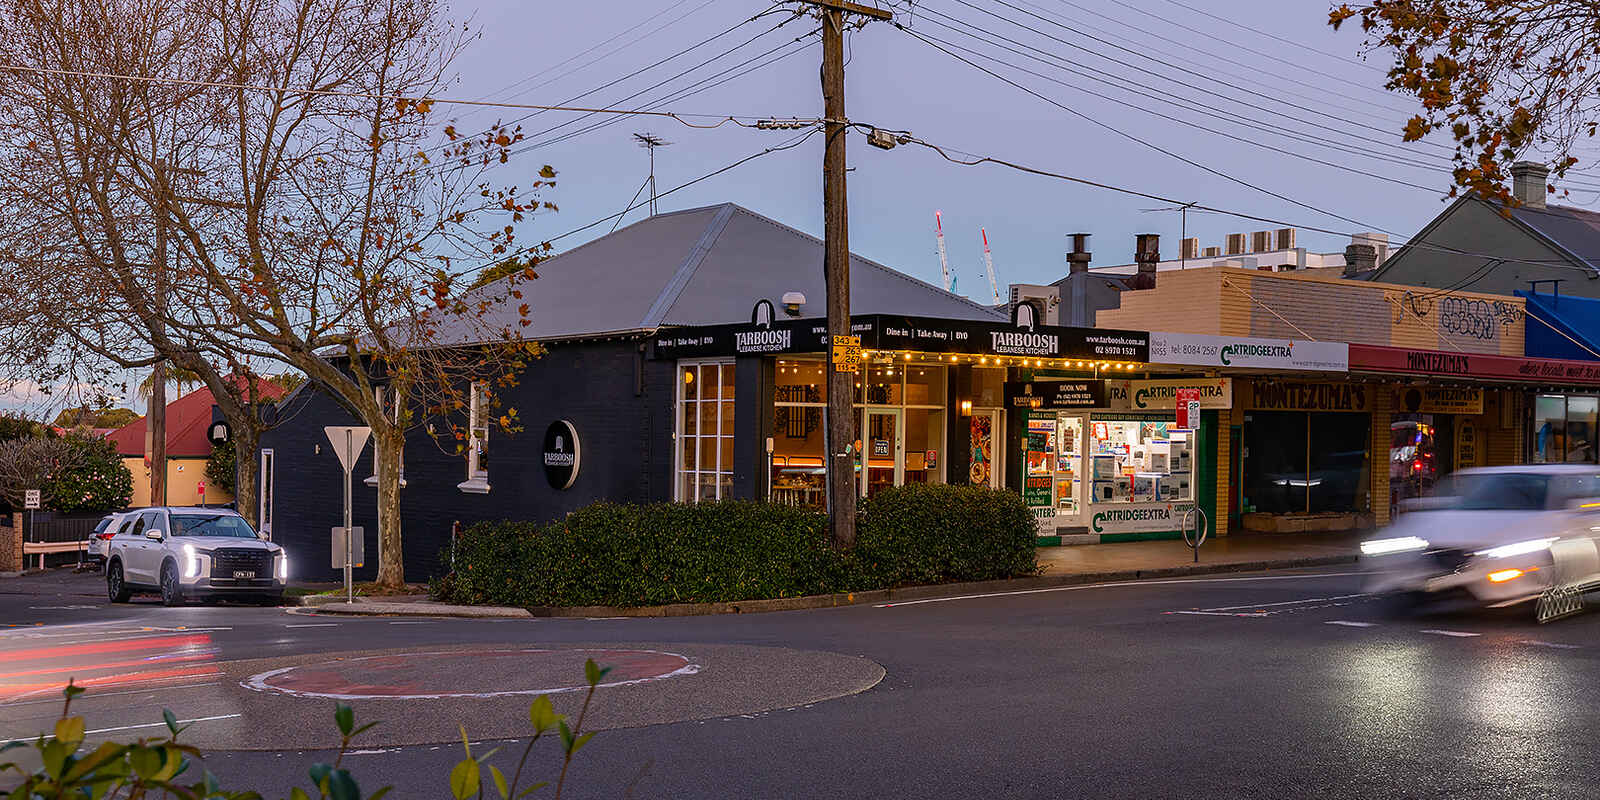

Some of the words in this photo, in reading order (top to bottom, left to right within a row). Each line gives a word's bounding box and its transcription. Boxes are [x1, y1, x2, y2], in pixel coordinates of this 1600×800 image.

[735, 330, 791, 350] TARBOOSH
[834, 337, 850, 345] 343
[990, 331, 1058, 353] TARBOOSH
[1085, 336, 1146, 346] www.tarboosh.com.au
[996, 346, 1025, 354] LEBANESE
[1024, 347, 1049, 355] KITCHEN
[1105, 346, 1121, 354] 8970
[1122, 347, 1136, 355] 1521
[1221, 344, 1292, 365] CARTRIDGEEXTRA
[1407, 352, 1469, 374] MONTEZUMA'S
[1189, 402, 1199, 411] 2P
[1252, 383, 1365, 410] MONTEZUMA'S
[1093, 509, 1170, 533] CARTRIDGEEXTRA
